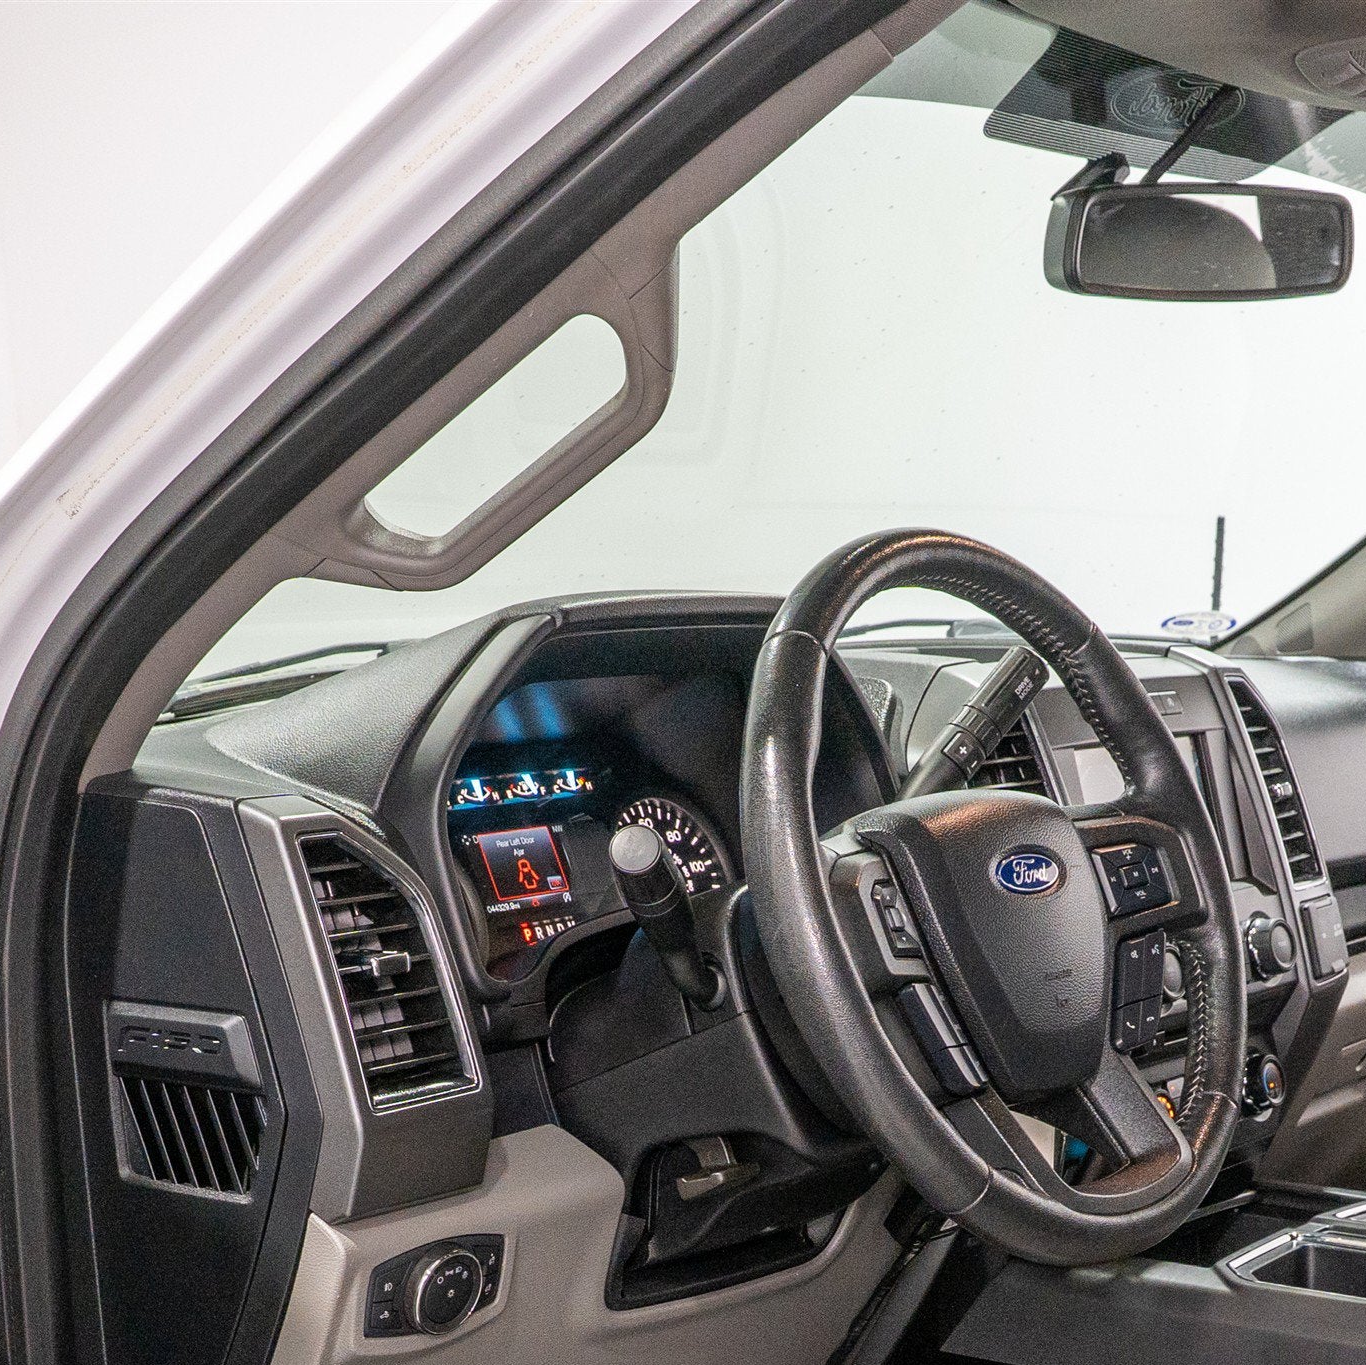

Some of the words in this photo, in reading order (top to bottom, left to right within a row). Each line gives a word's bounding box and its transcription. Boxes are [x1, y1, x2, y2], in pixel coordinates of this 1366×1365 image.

[1015, 676, 1031, 695] DRIVE
[509, 838, 521, 846] Left
[520, 837, 535, 845] Door
[666, 830, 682, 843] 80
[689, 860, 705, 873] 100
[1012, 859, 1049, 885] Ford
[523, 928, 532, 941] P
[535, 926, 545, 940] R
[545, 924, 555, 937] N
